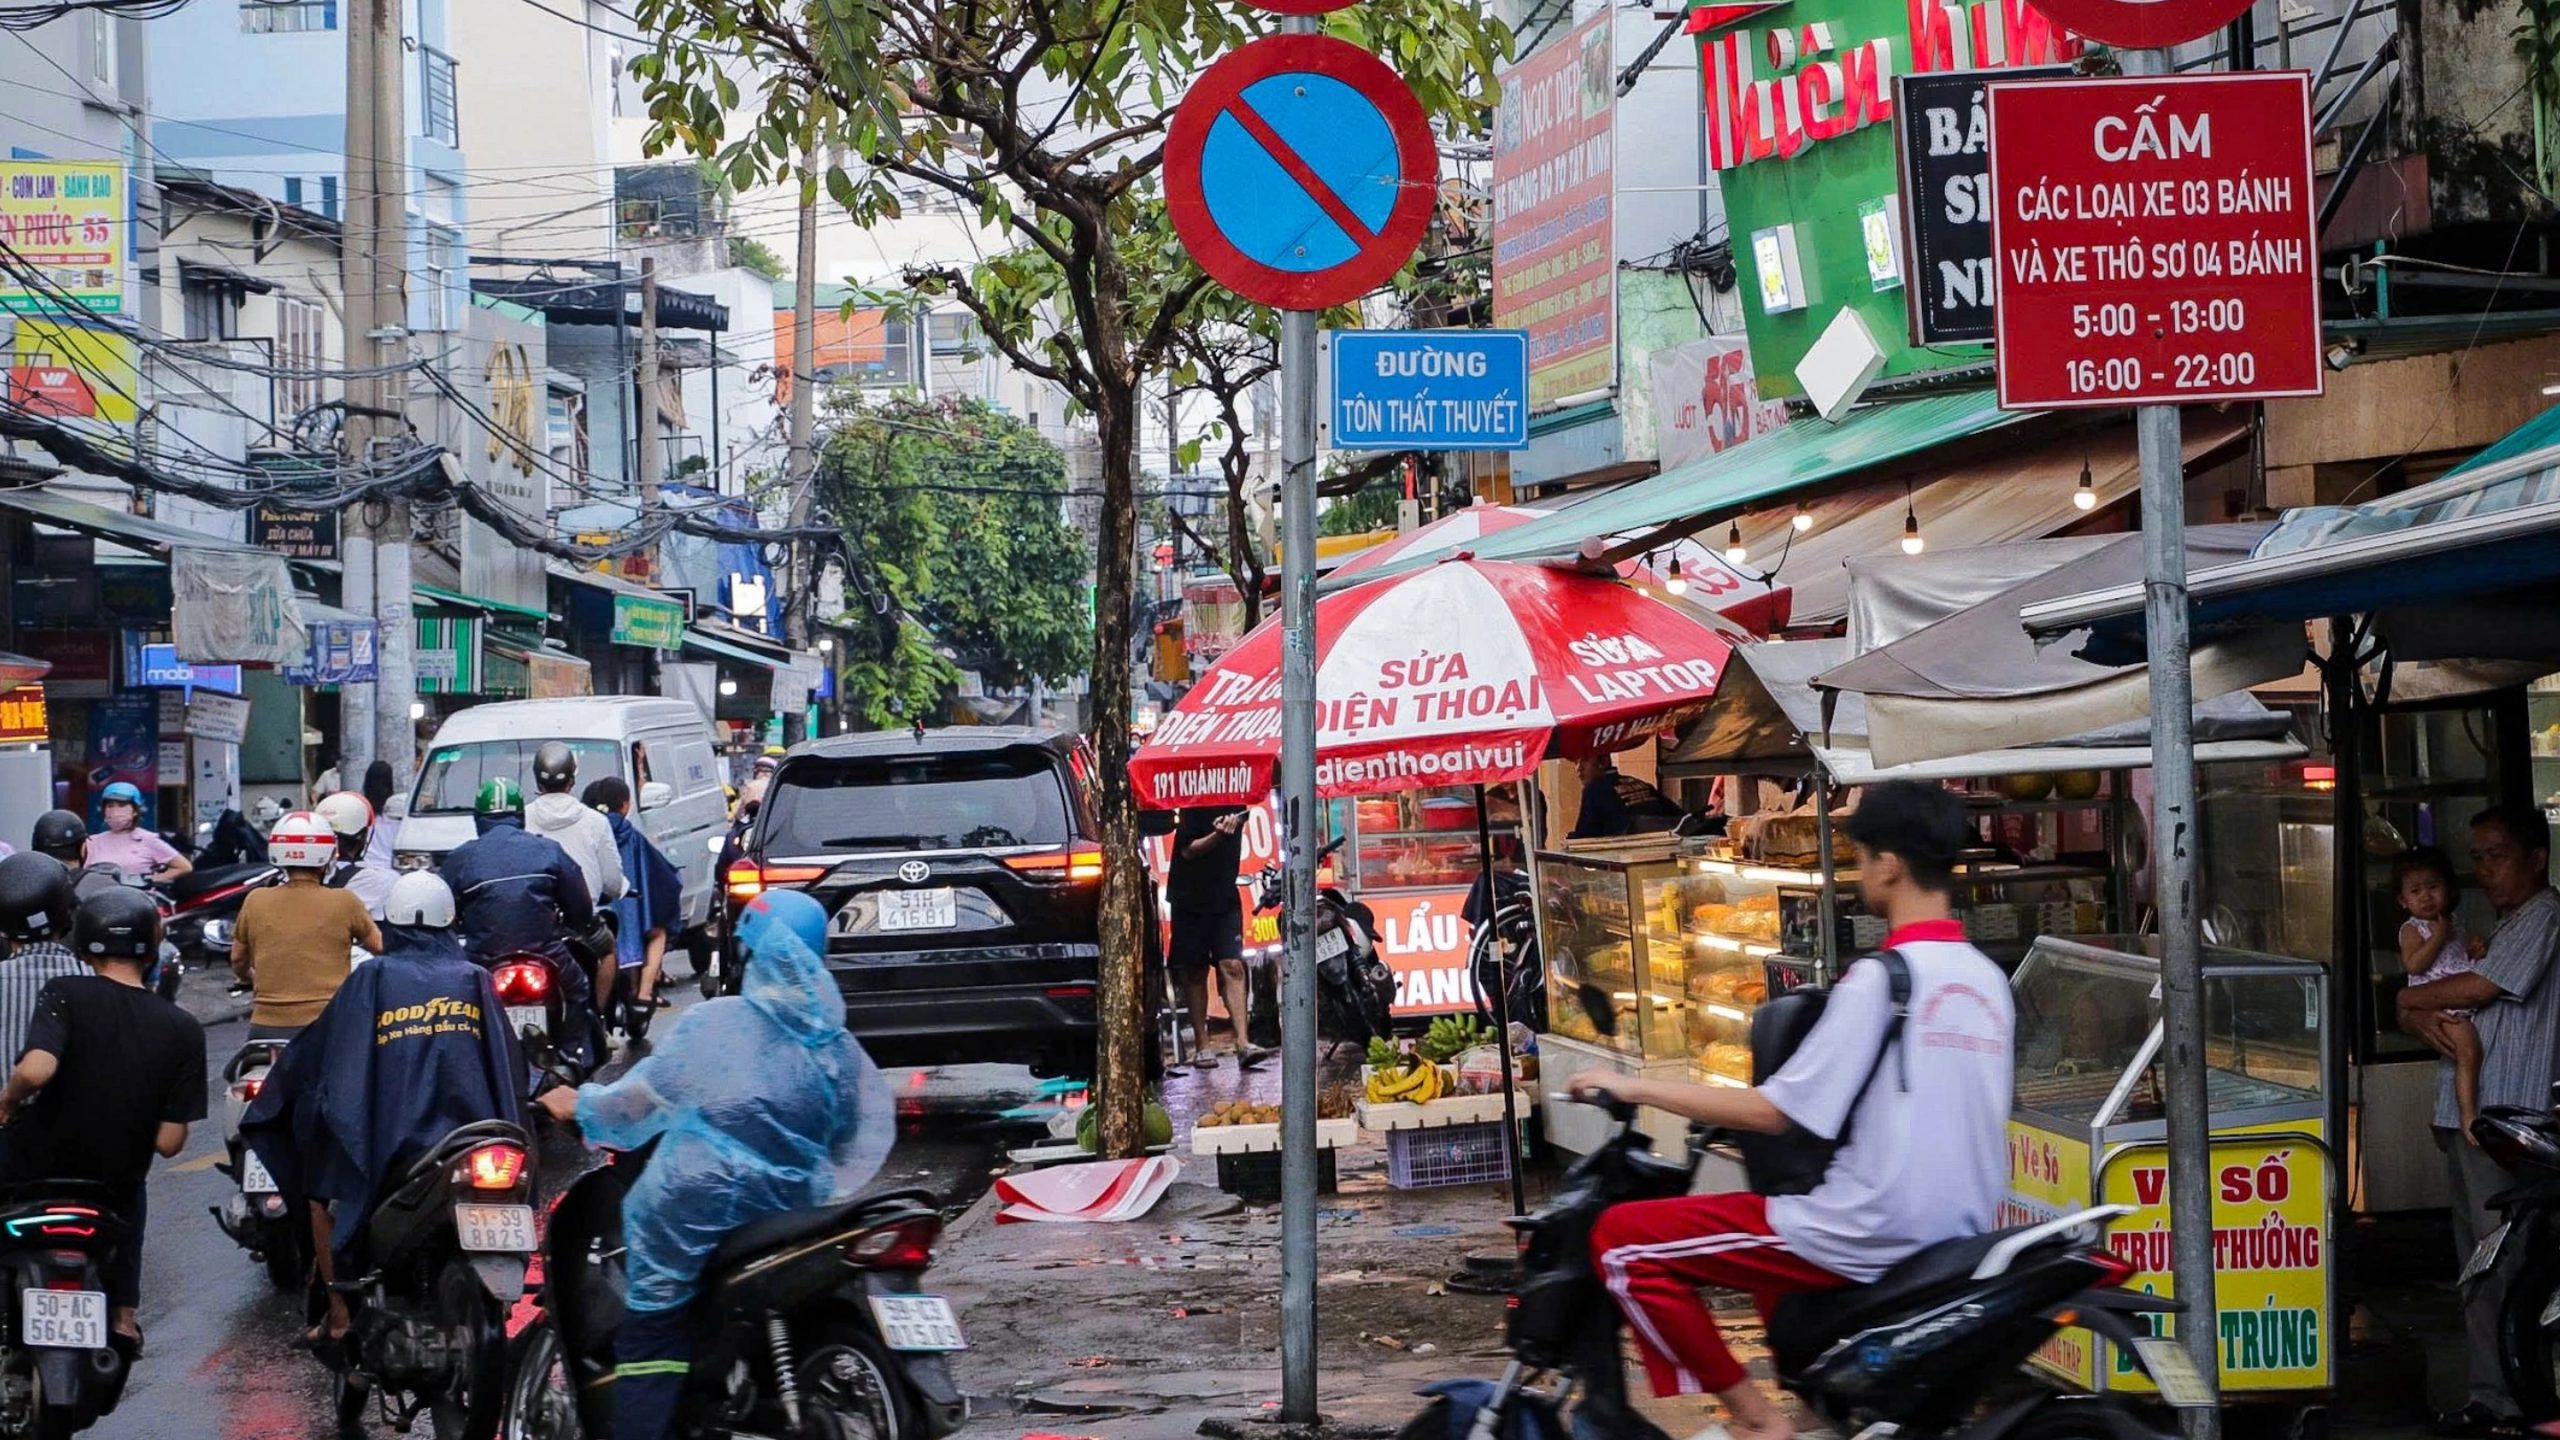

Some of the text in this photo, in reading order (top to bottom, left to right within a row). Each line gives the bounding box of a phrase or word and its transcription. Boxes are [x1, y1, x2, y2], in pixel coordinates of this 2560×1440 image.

[1523, 75, 1553, 147] NGỌC
[1925, 90, 1988, 156] BÁ
[2094, 95, 2211, 162] CẤM
[2017, 168, 2292, 226] CÁC LOẠI XE 03 BÁNH
[24, 205, 73, 246] PHÚC
[2010, 230, 2303, 284] VÀ XE THÔ SƠ 04 BÁNH
[2073, 303, 2136, 338] 5:00
[2170, 299, 2245, 334] 13:00
[1375, 345, 1487, 377] ĐƯỜNG
[2066, 357, 2141, 393] 16:00
[2174, 352, 2255, 388] 22:00
[1342, 387, 1518, 434] TÔN THẤT THUYẾT
[1379, 649, 1469, 689] SỬA
[1569, 632, 1664, 667] SỬA
[1413, 675, 1543, 723] THOẠI
[1567, 659, 1716, 704] LAPTOP
[1214, 707, 1282, 746] THOẠ
[1592, 722, 1625, 748] 191
[1153, 761, 1252, 799] 191 KHÁNH HỘI
[1315, 741, 1525, 786] dienthoaivui
[1385, 900, 1458, 954] LẨU
[404, 1023, 432, 1037] Hàng
[2132, 1151, 2291, 1205] V SỐ
[472, 1228, 525, 1248] 8825
[2110, 1210, 2320, 1273] TRÚ THƯỞNG
[36, 1294, 92, 1318] 50-AC
[31, 1318, 97, 1344] 564.91
[2219, 1295, 2319, 1370] TRÚNG
